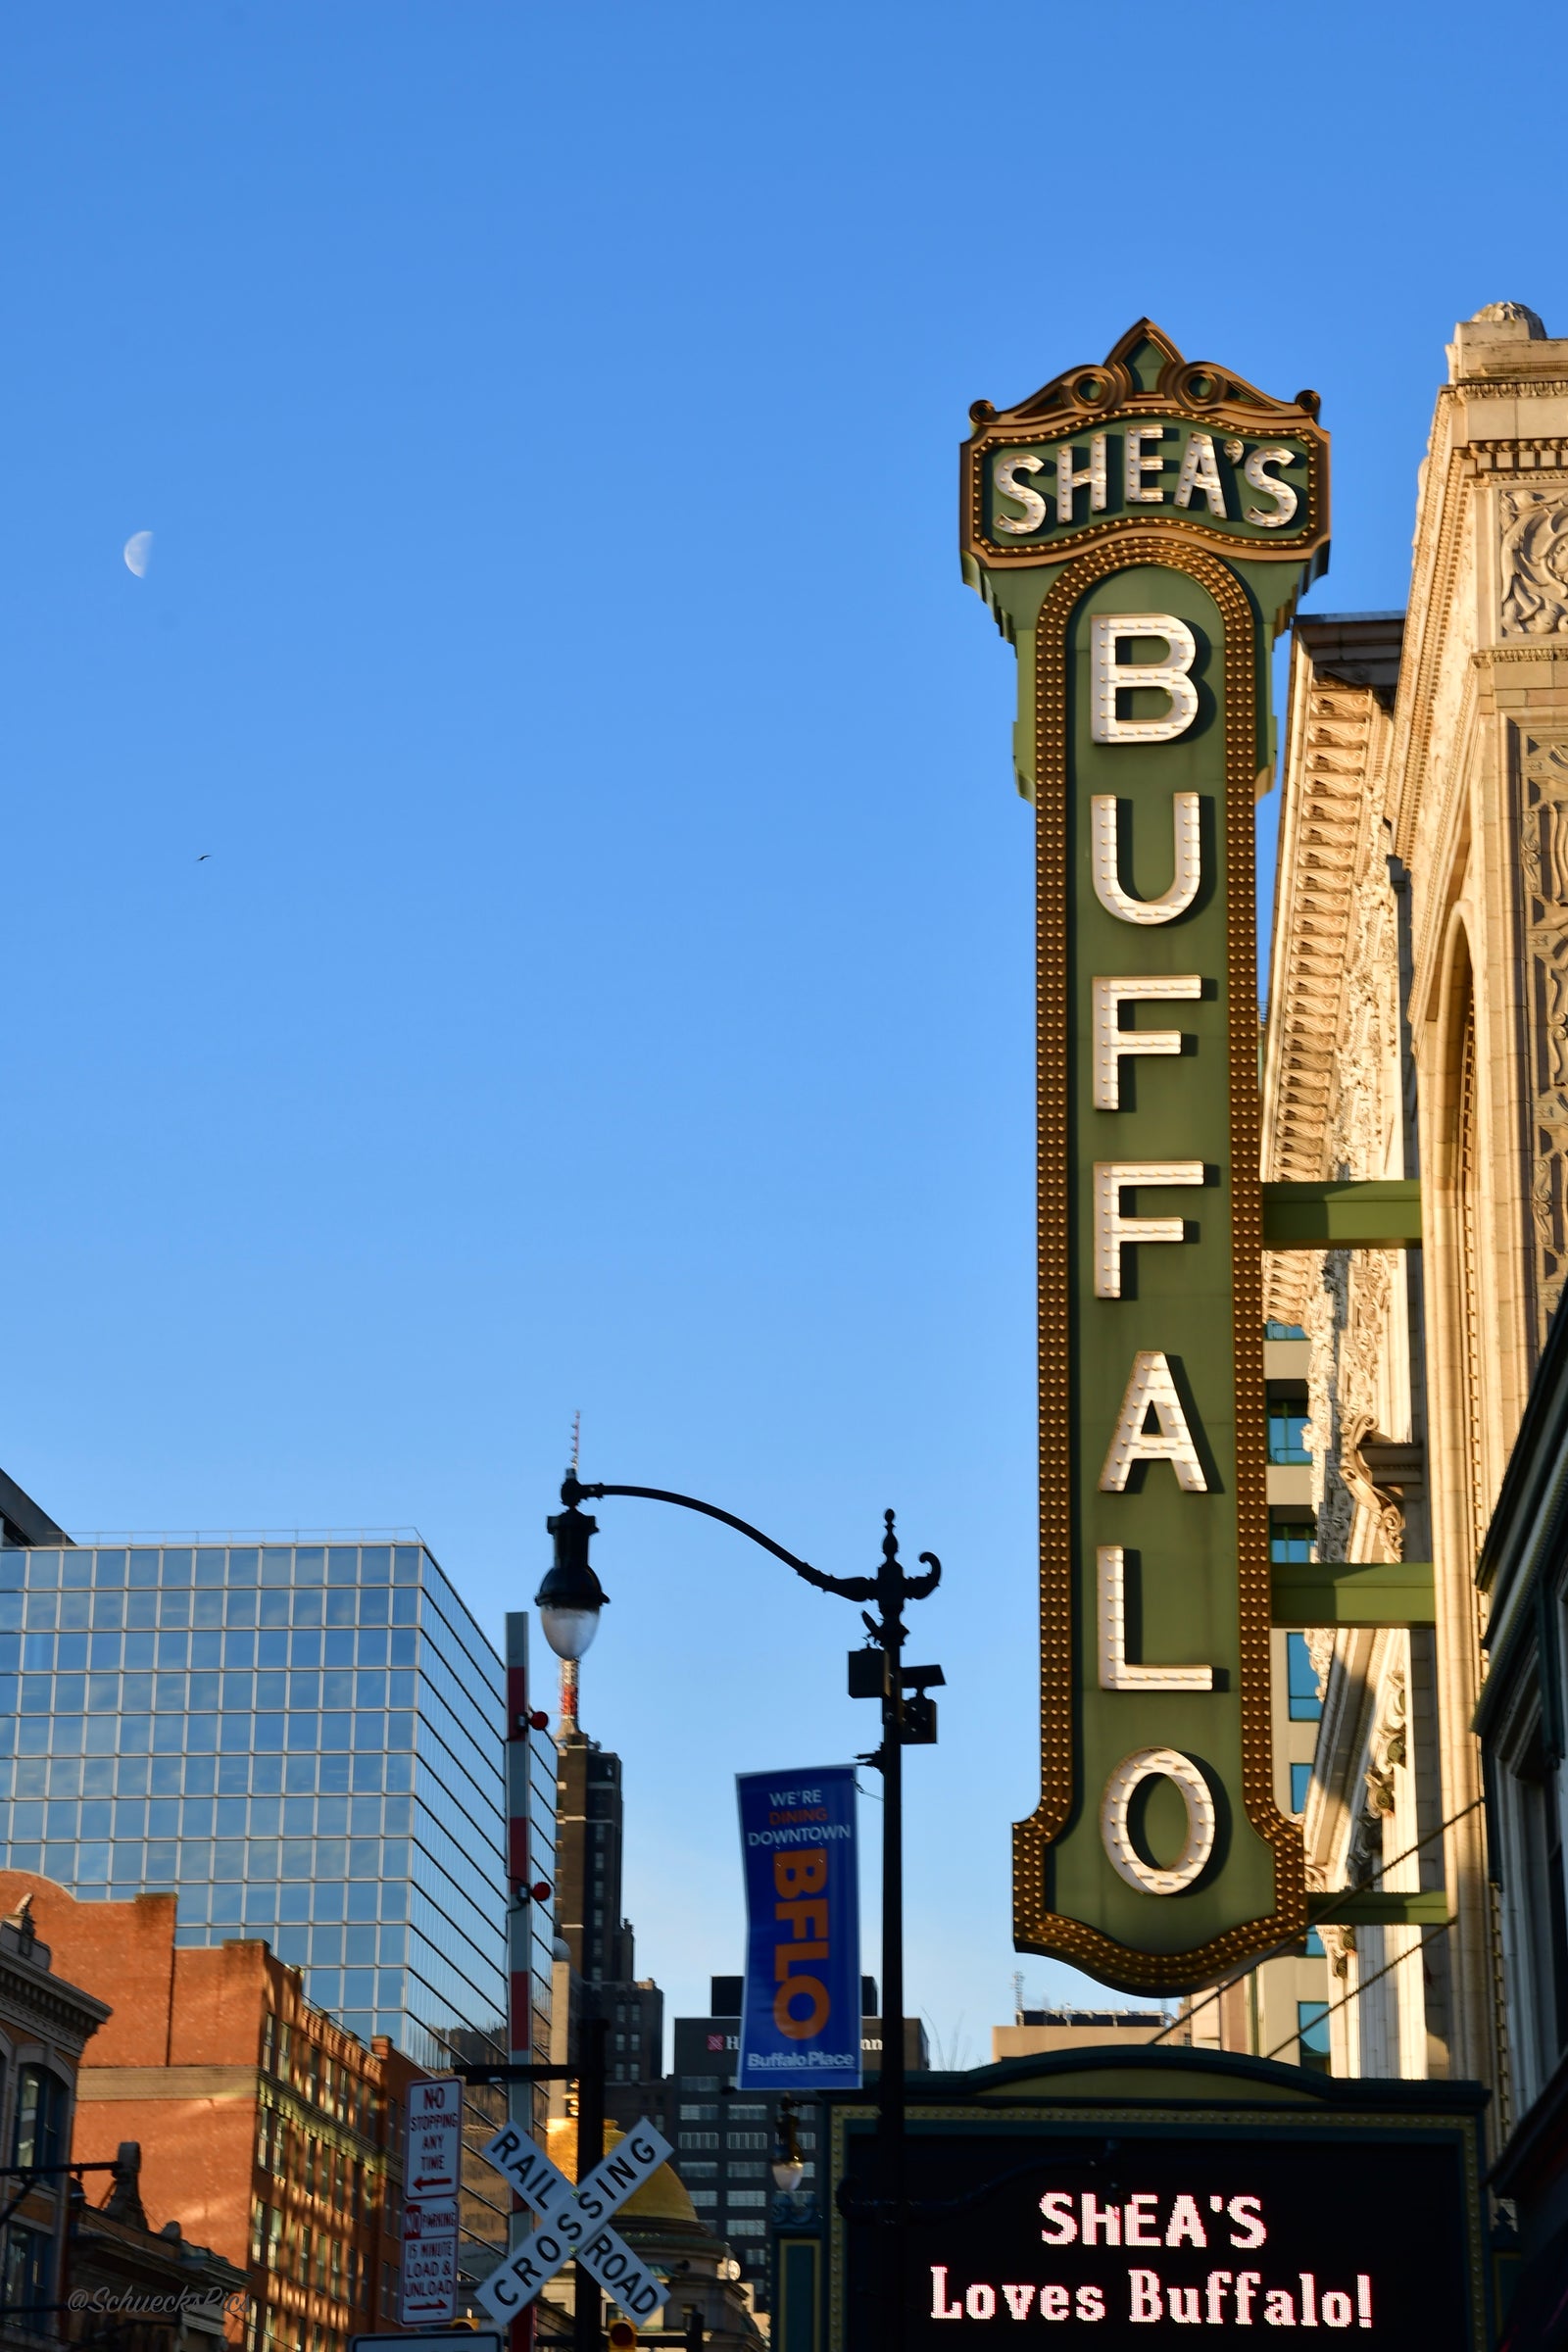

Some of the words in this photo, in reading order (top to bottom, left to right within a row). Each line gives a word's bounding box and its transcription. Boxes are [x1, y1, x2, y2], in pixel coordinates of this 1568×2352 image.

[994, 423, 1298, 535] SHEA'S
[1090, 612, 1216, 1895] BUFFALO
[768, 1789, 822, 1807] WE'RE
[768, 1807, 828, 1826] DINING
[748, 1825, 852, 1846] DOWNTOWN
[773, 1848, 830, 2039] BFLO
[747, 2053, 808, 2068] Buffalo
[808, 2050, 855, 2067] Place
[423, 2086, 446, 2110] NO
[410, 2113, 458, 2132] STOPPING
[422, 2134, 444, 2150] ANY
[420, 2155, 445, 2171] TIME
[491, 2130, 558, 2211] RAIL
[421, 2212, 456, 2228] PARKING
[493, 2136, 657, 2307] CROSSING
[1039, 2192, 1267, 2249] SHEA'S
[408, 2243, 417, 2259] 15
[420, 2240, 453, 2258] MINUTE
[407, 2261, 439, 2278] LOAD
[443, 2260, 452, 2276] &
[585, 2233, 660, 2316] ROAD
[405, 2278, 453, 2298] UNLOAD
[930, 2266, 1107, 2321] Loves
[1128, 2269, 1373, 2328] Buffalo!
